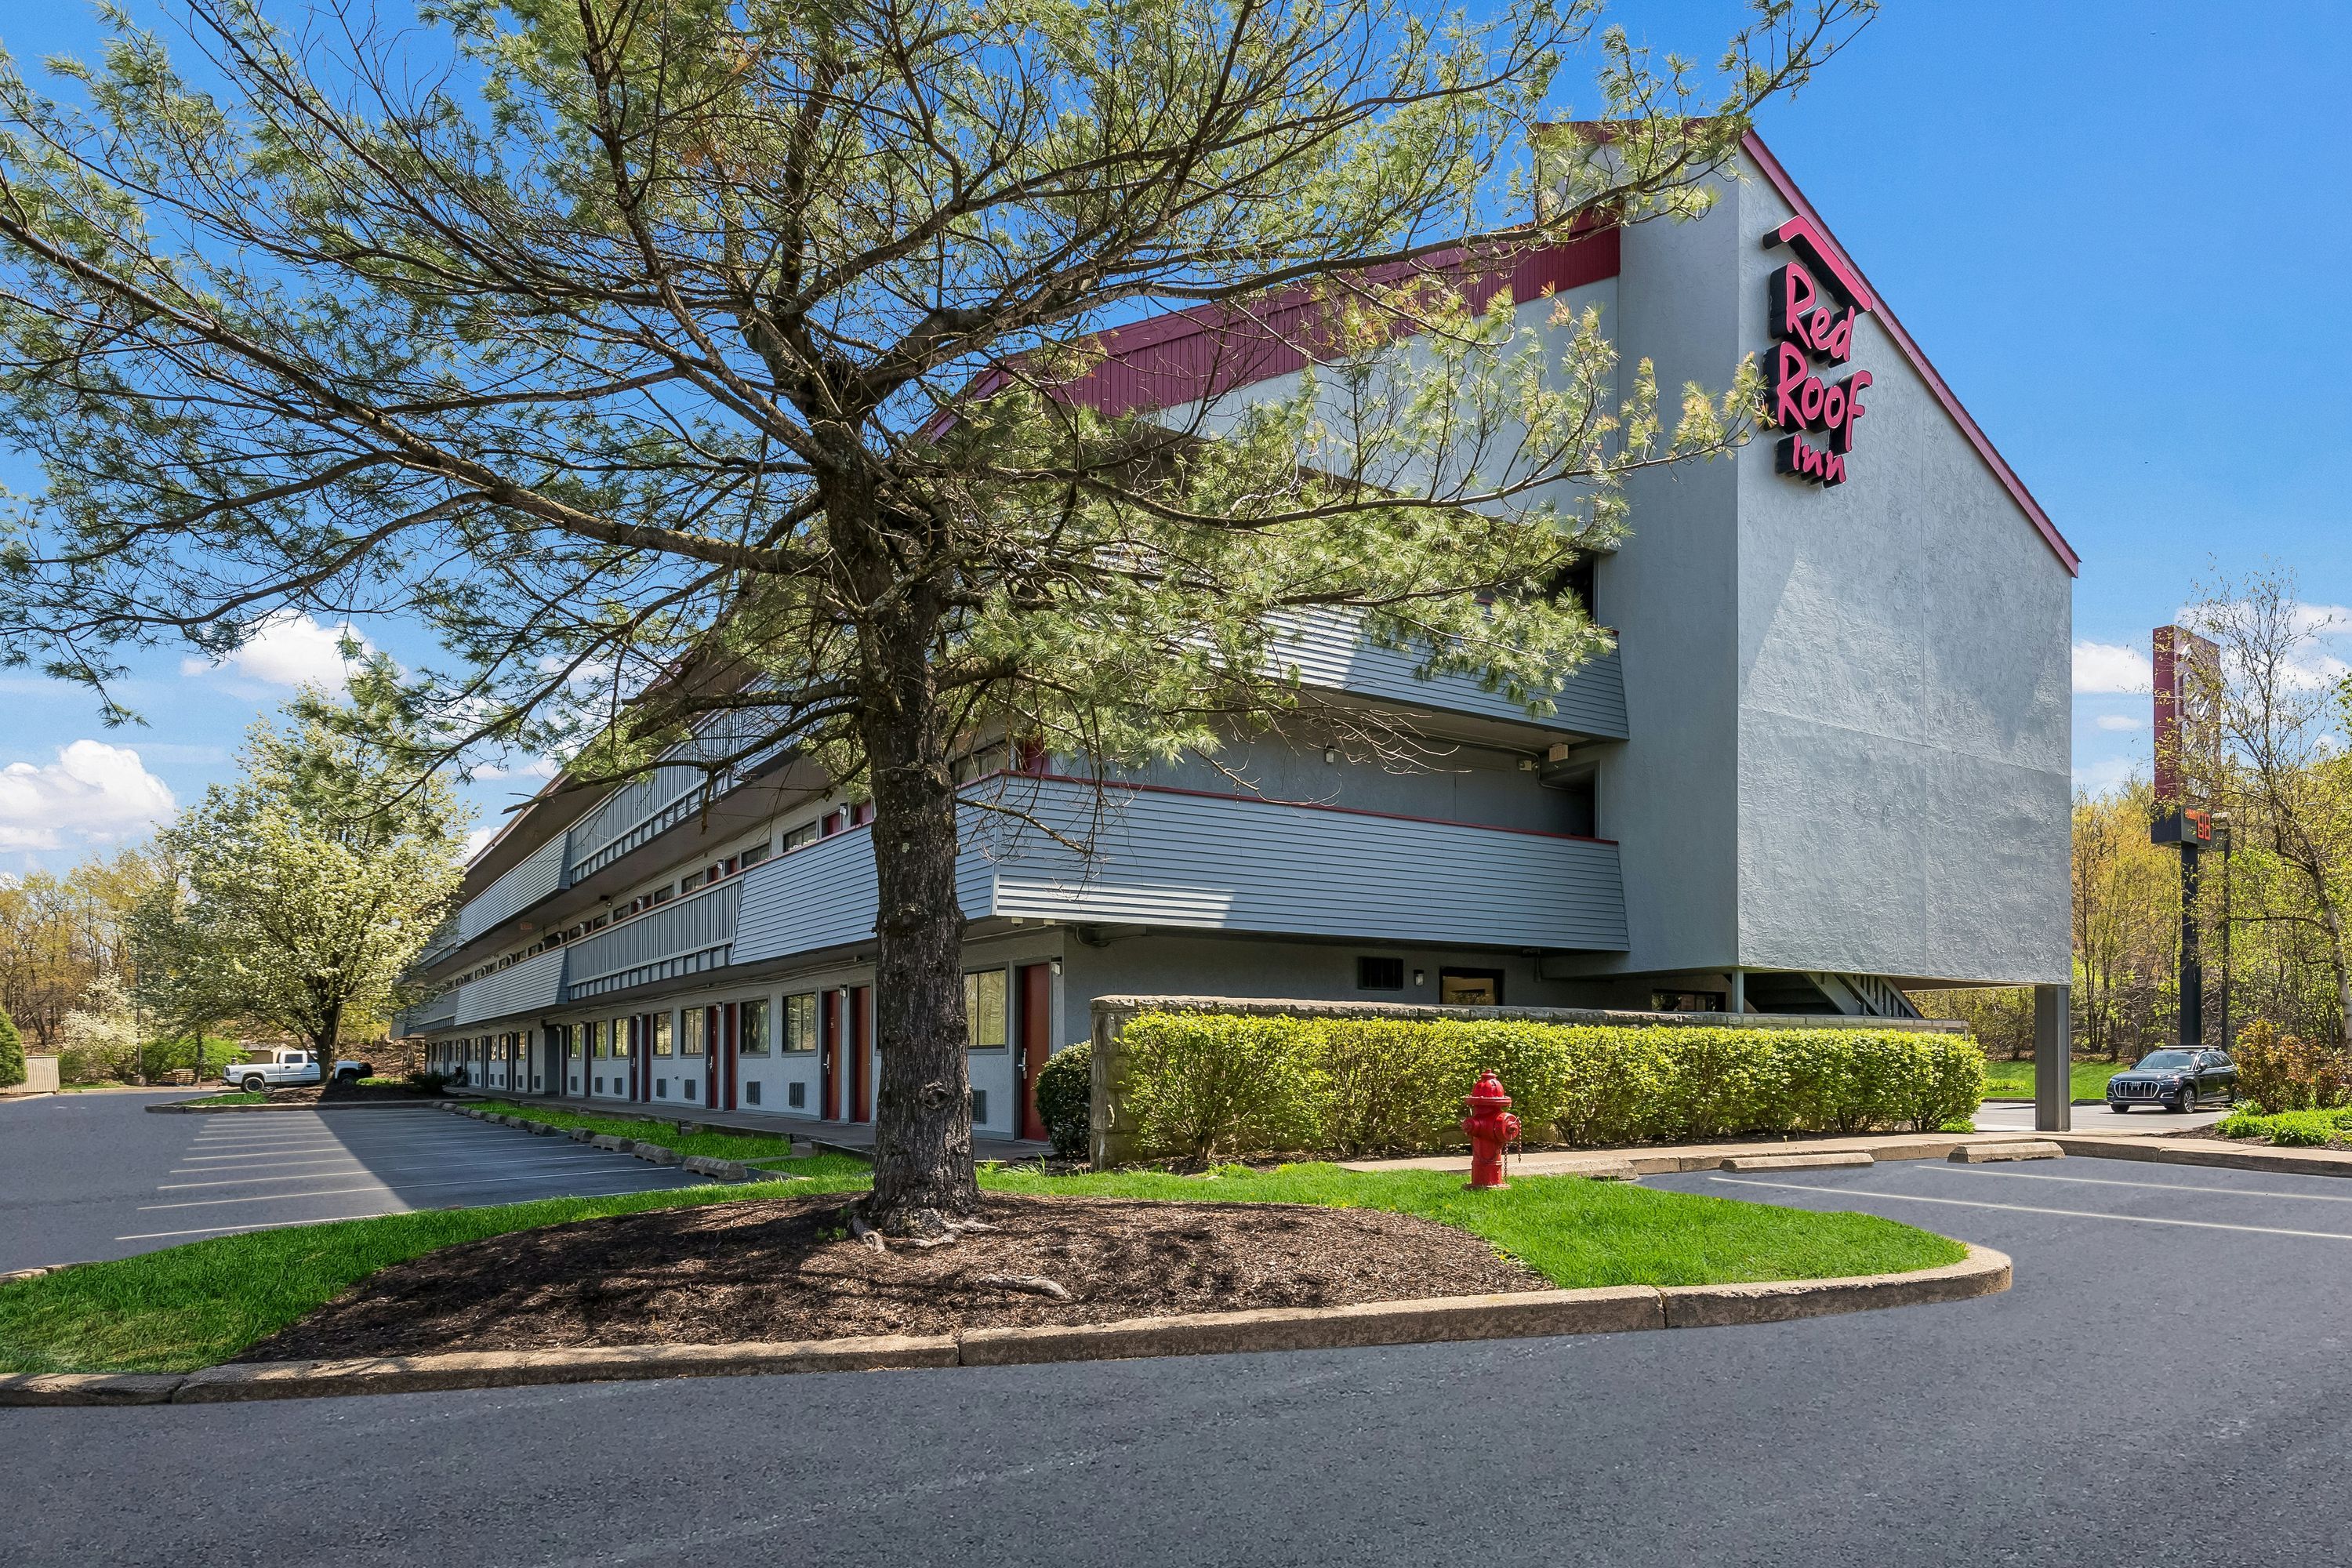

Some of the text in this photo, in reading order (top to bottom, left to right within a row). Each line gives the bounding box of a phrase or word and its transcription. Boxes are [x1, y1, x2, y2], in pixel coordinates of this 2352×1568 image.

[1786, 261, 1856, 362] Red
[1777, 341, 1873, 453] Roof
[1792, 434, 1847, 485] Inn
